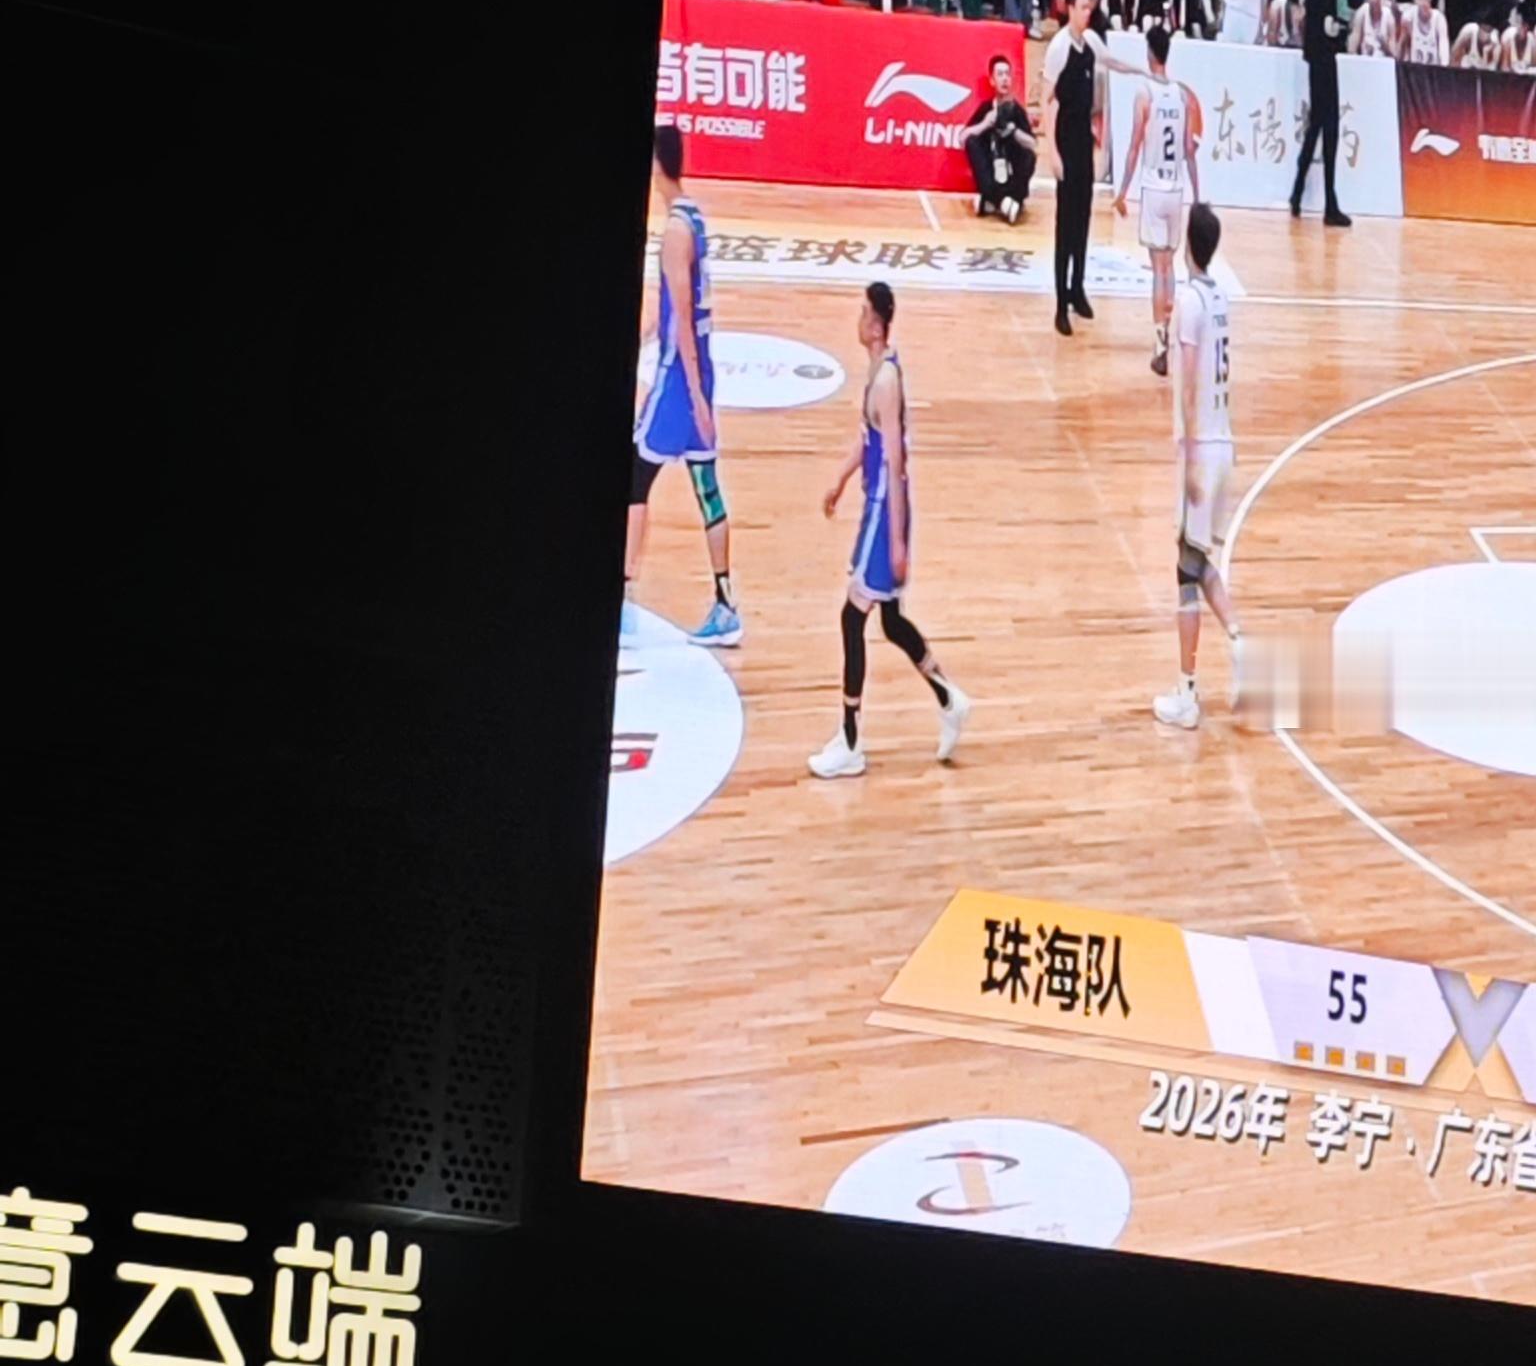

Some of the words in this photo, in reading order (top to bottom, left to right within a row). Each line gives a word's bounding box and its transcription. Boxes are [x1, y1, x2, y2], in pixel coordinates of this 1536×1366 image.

[1162, 125, 1176, 162] 2
[980, 916, 1131, 1019] 珠海队
[1327, 969, 1369, 1025] 55
[1138, 1069, 1291, 1157] 2026年
